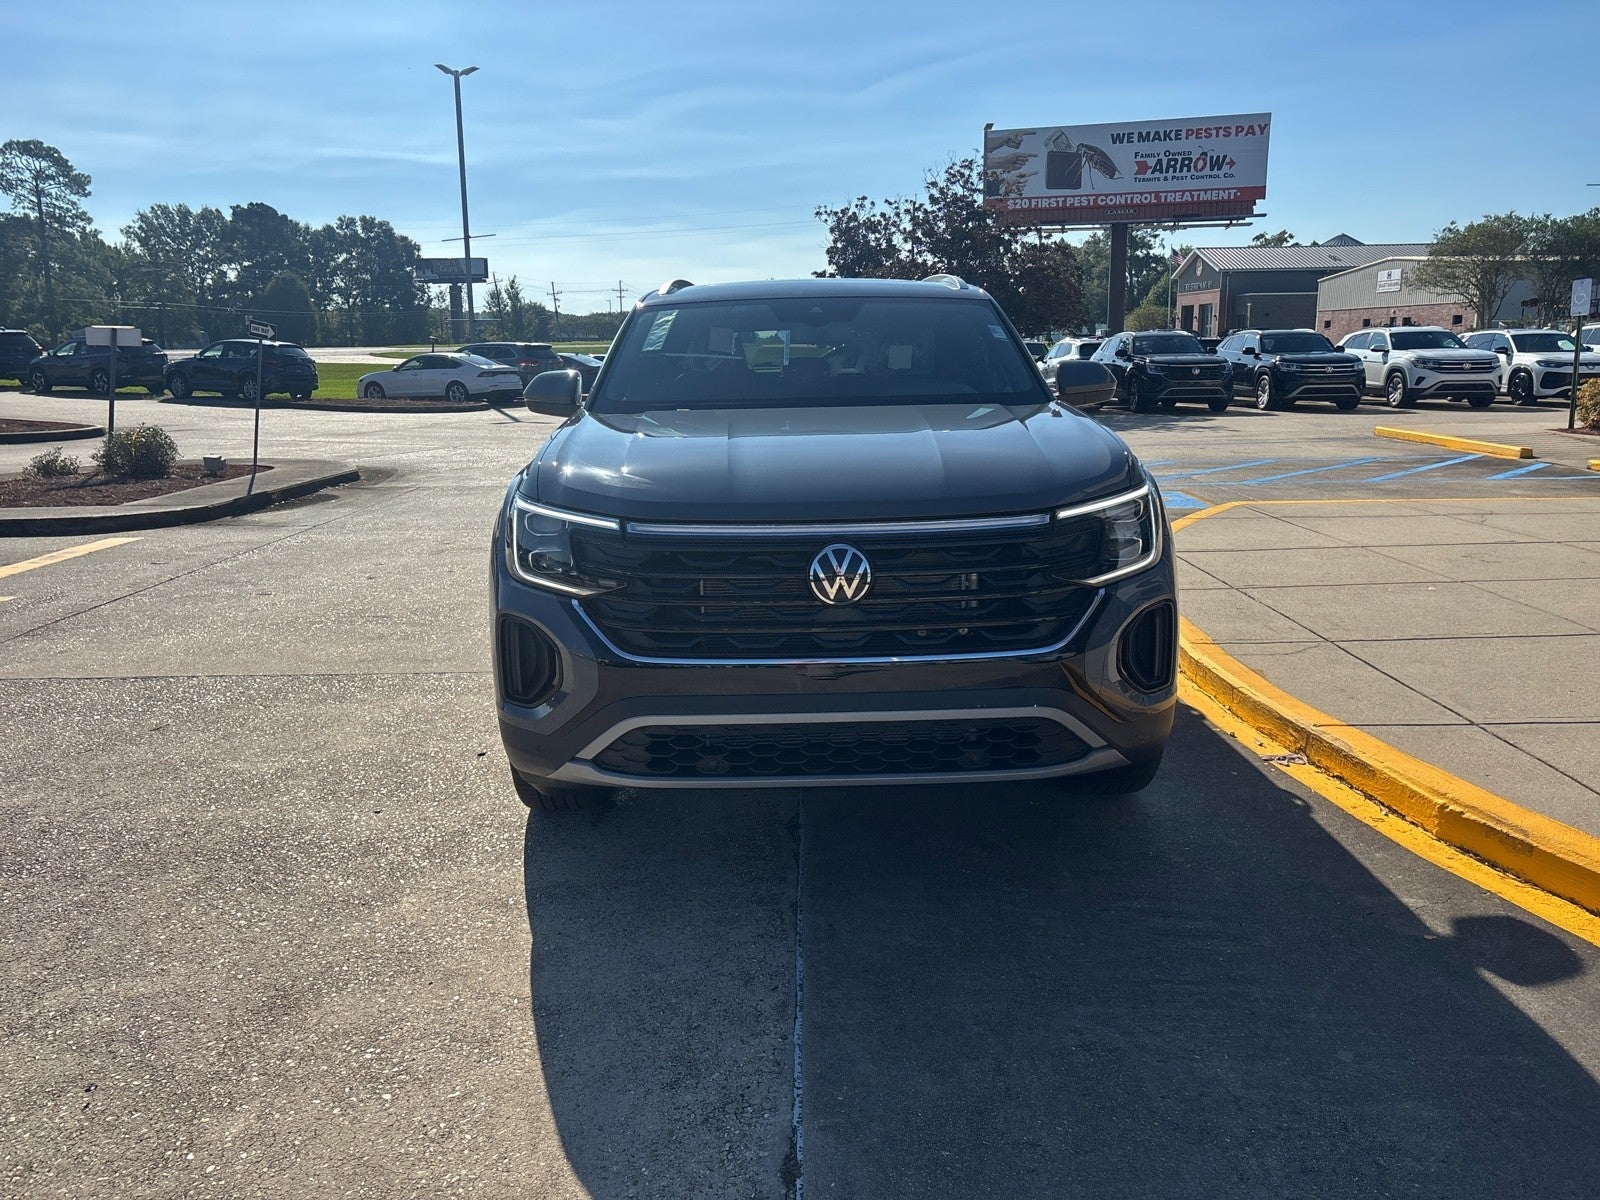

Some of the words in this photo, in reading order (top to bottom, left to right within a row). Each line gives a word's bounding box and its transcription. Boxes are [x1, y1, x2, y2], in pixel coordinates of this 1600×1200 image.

[1111, 132, 1135, 145] WE
[1137, 129, 1183, 143] MAKE
[1185, 126, 1232, 140] PESTS
[1234, 123, 1269, 137] PAY
[1150, 153, 1227, 174] ARROW
[1007, 199, 1030, 210] $20
[1031, 197, 1064, 209] FIRST
[1066, 195, 1096, 207] PEST
[1097, 192, 1157, 206] CONTROL
